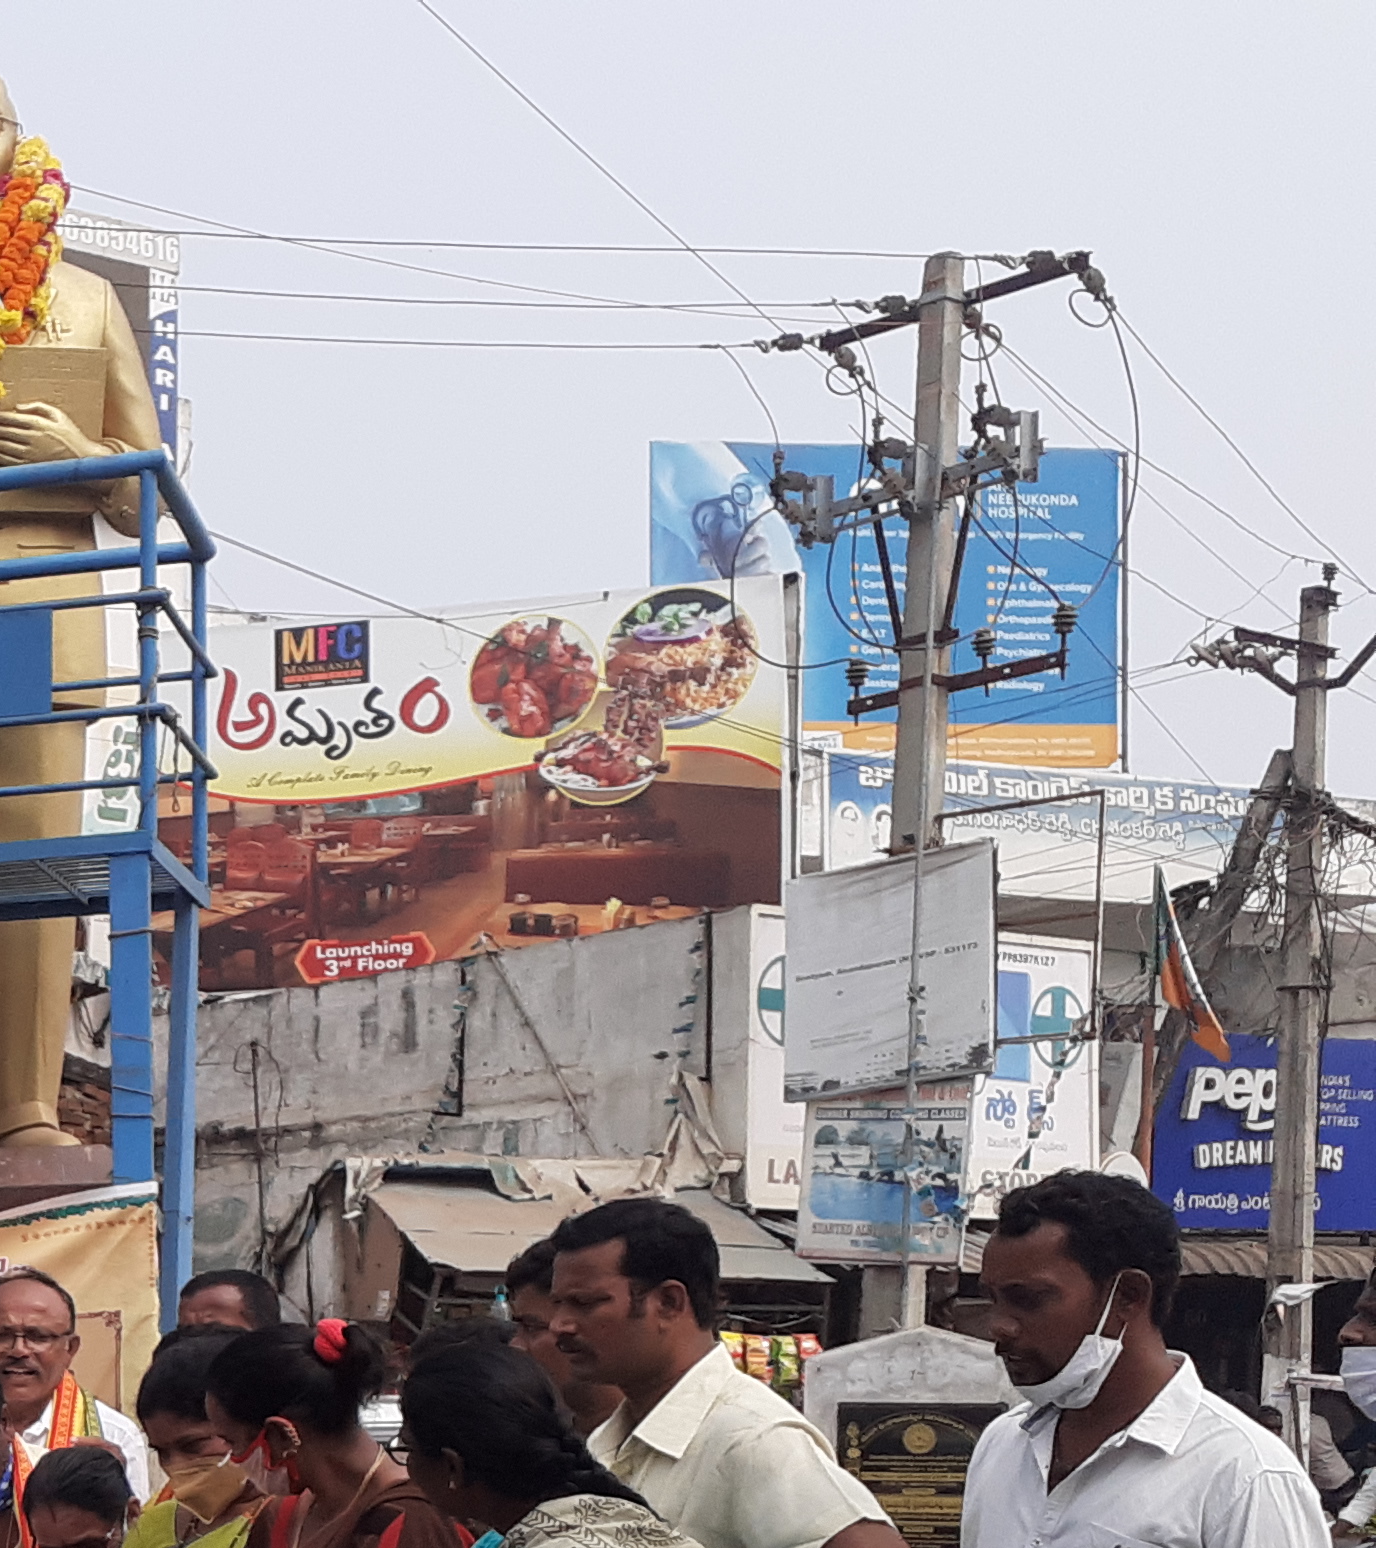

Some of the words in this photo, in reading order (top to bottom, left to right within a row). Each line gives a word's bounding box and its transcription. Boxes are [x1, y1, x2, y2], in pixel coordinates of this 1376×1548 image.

[281, 623, 363, 665] MFC
[217, 667, 450, 760] అమృతం
[315, 939, 413, 960] Launching
[357, 956, 408, 972] Floor
[1319, 1115, 1360, 1128] ATTRESS
[1194, 1140, 1262, 1169] DREAM
